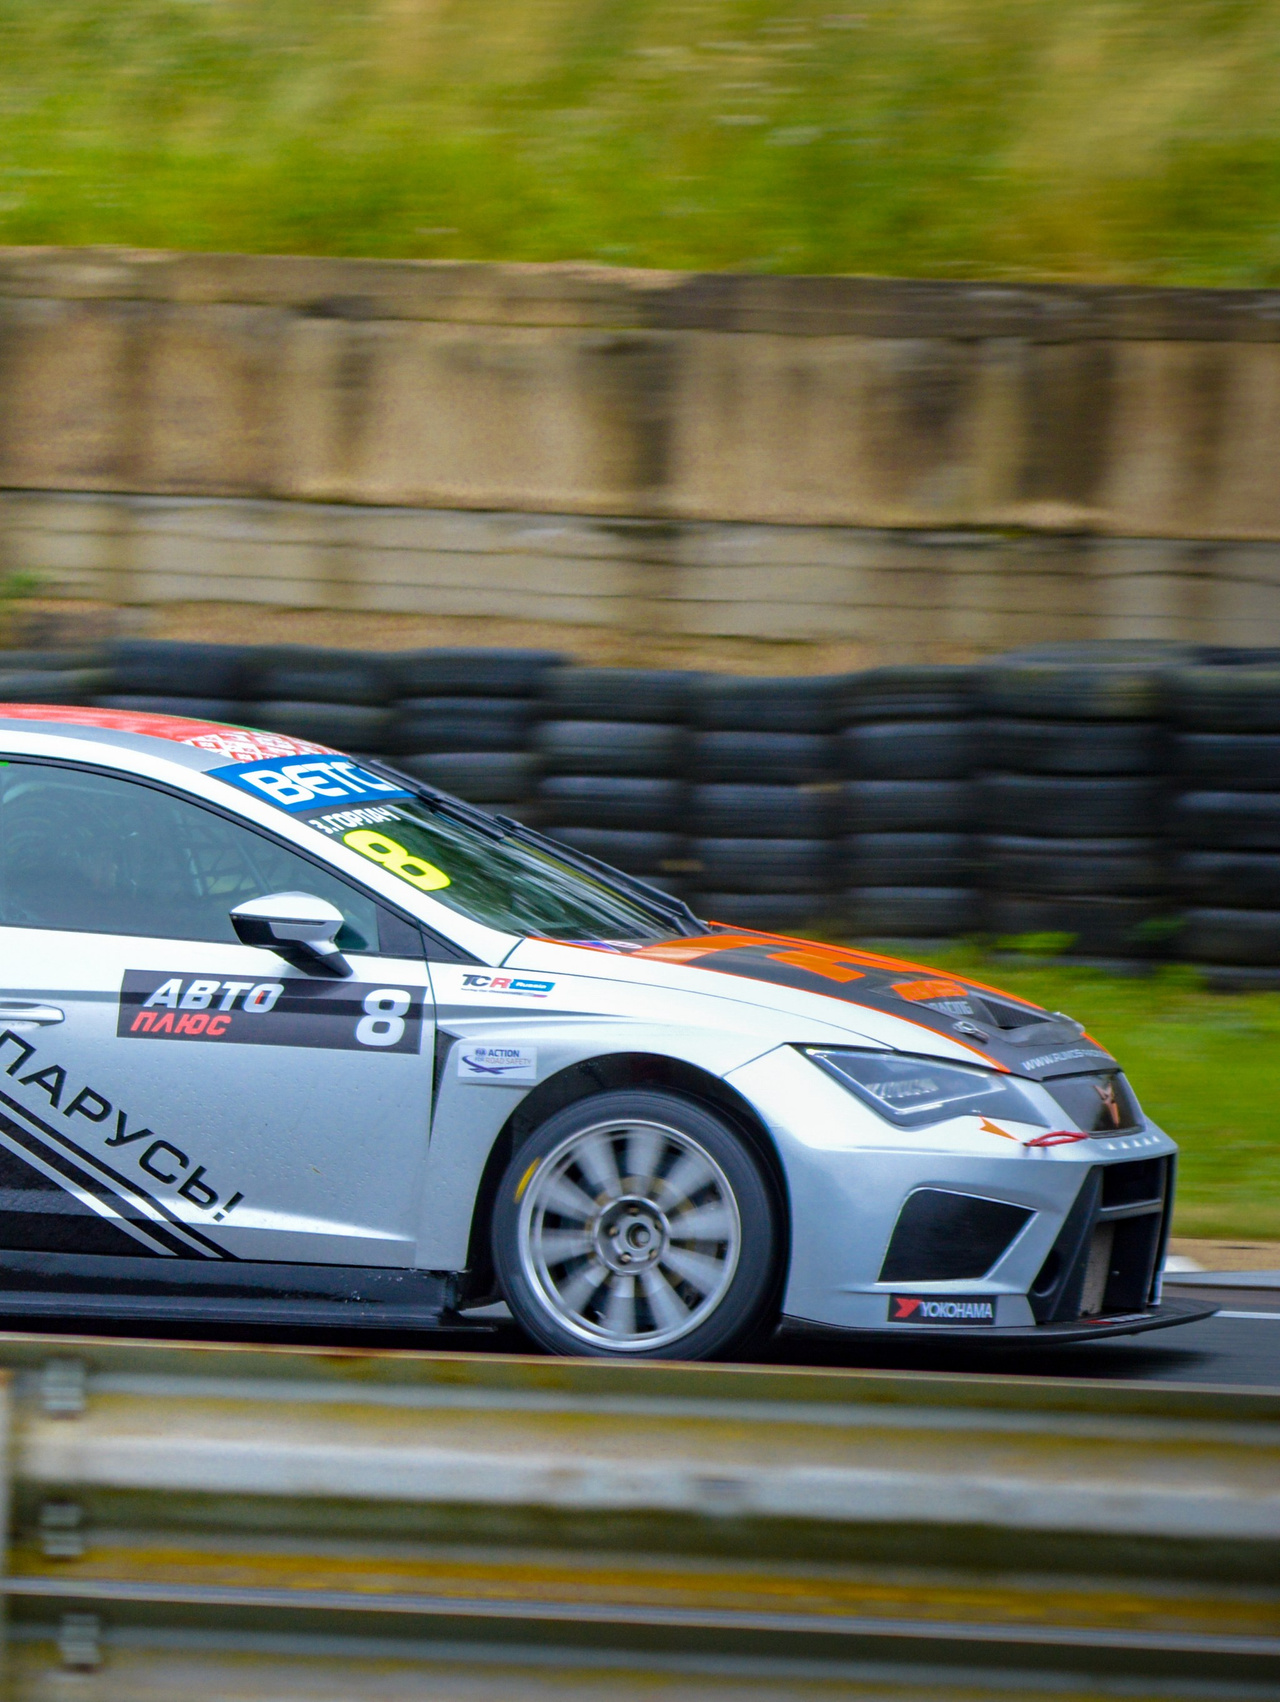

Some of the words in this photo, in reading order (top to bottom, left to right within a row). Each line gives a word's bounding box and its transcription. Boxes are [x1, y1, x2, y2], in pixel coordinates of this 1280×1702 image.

[343, 829, 451, 891] 8
[462, 974, 512, 989] TCR
[144, 978, 285, 1013] АВТО
[130, 1012, 232, 1036] ПЛЮС
[353, 988, 412, 1047] 8
[488, 1049, 520, 1058] ACTION
[921, 1301, 993, 1320] YOKOHAMA
